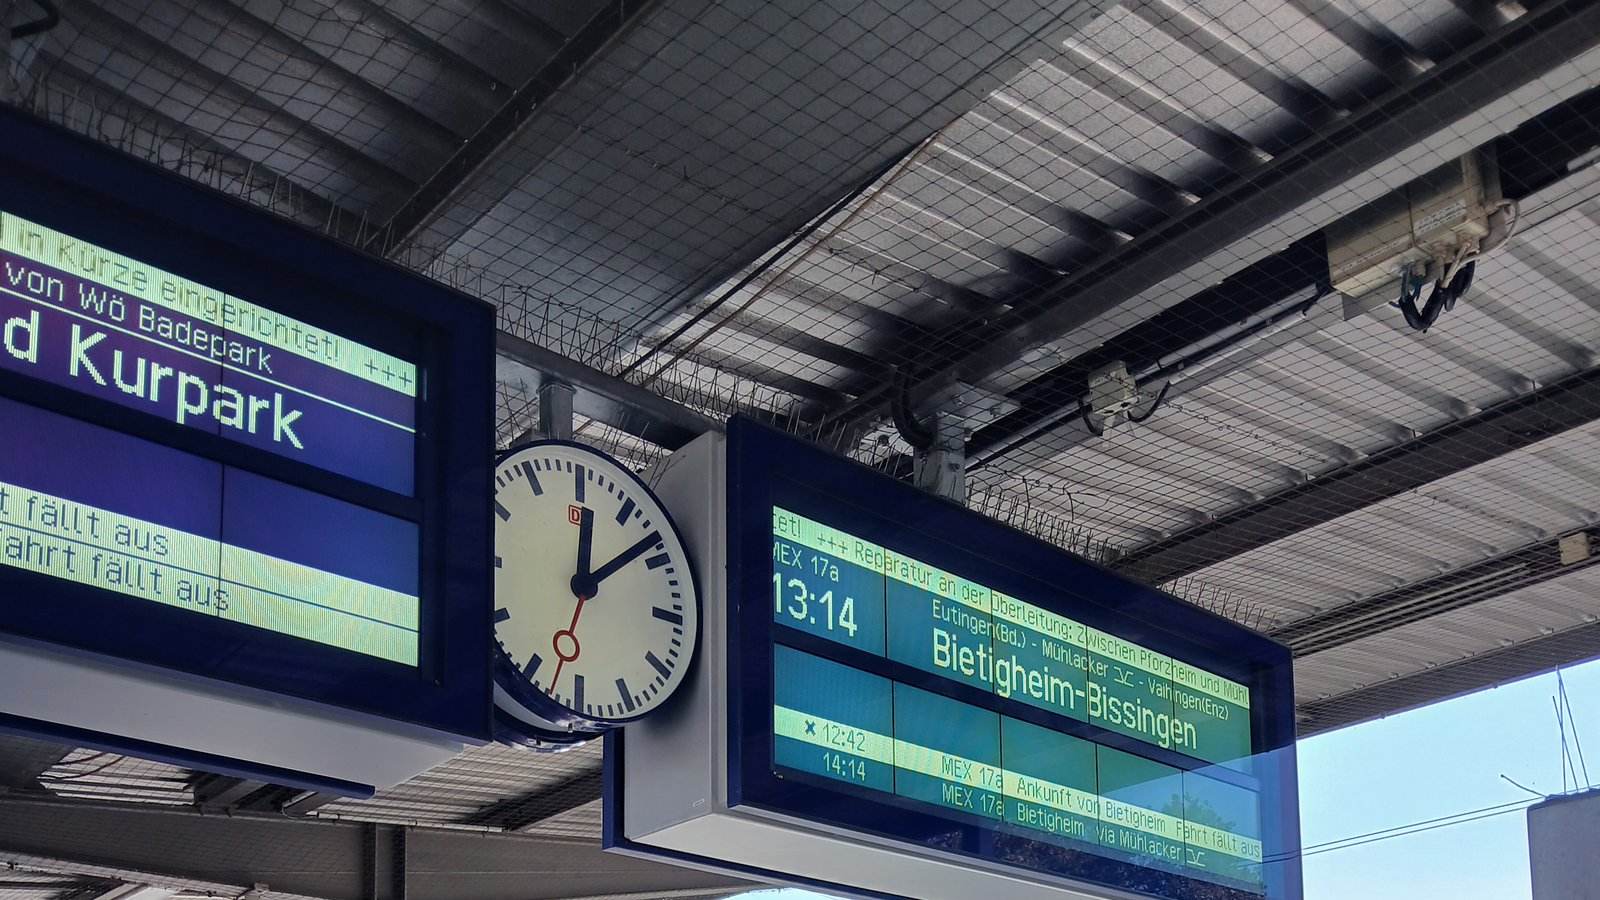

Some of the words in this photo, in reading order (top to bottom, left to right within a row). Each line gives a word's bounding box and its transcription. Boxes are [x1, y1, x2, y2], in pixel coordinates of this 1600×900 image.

[6, 262, 64, 301] von
[79, 283, 125, 322] Wö
[139, 304, 272, 374] Badepark
[20, 222, 44, 253] in
[59, 237, 148, 292] Kürze
[162, 280, 339, 363] eingerichtet!
[4, 310, 39, 363] d
[70, 323, 304, 450] Kurpark
[0, 530, 76, 573] ahrt
[92, 553, 162, 595] fällt
[177, 580, 229, 611] aus
[27, 496, 100, 539] fällt
[115, 524, 168, 556] aus
[811, 555, 839, 582] 17a
[773, 572, 858, 637] 13:14
[855, 541, 933, 586] Reparatur
[939, 577, 956, 596] an
[962, 584, 985, 606] der
[992, 593, 1073, 640] Oberleitung:
[1077, 625, 1136, 662] Zwischen
[1140, 650, 1197, 685] Pforzheim
[1200, 677, 1220, 694] und
[932, 599, 1027, 649] Eutingen(Bd.)
[1042, 638, 1109, 678] Mühlacker
[1148, 677, 1229, 720] Vaihingen(Enz)
[933, 628, 1197, 749] Bietigheim-Bissingen
[823, 723, 866, 752] 12:42
[941, 756, 973, 782] MEX
[980, 767, 1004, 789] 17a
[1017, 777, 1072, 808] Ankunft
[1077, 796, 1101, 817] von
[1106, 801, 1166, 833] Bietigheim
[1176, 820, 1208, 845] Fahrt
[1212, 831, 1237, 852] fällt
[1241, 842, 1260, 858] aus
[823, 752, 866, 782] 14:14
[942, 783, 973, 809] MEX
[980, 794, 1005, 817] 17a
[1017, 803, 1085, 837] Bietigheim
[1096, 826, 1115, 845] via
[1119, 829, 1181, 861] Mühlacker
